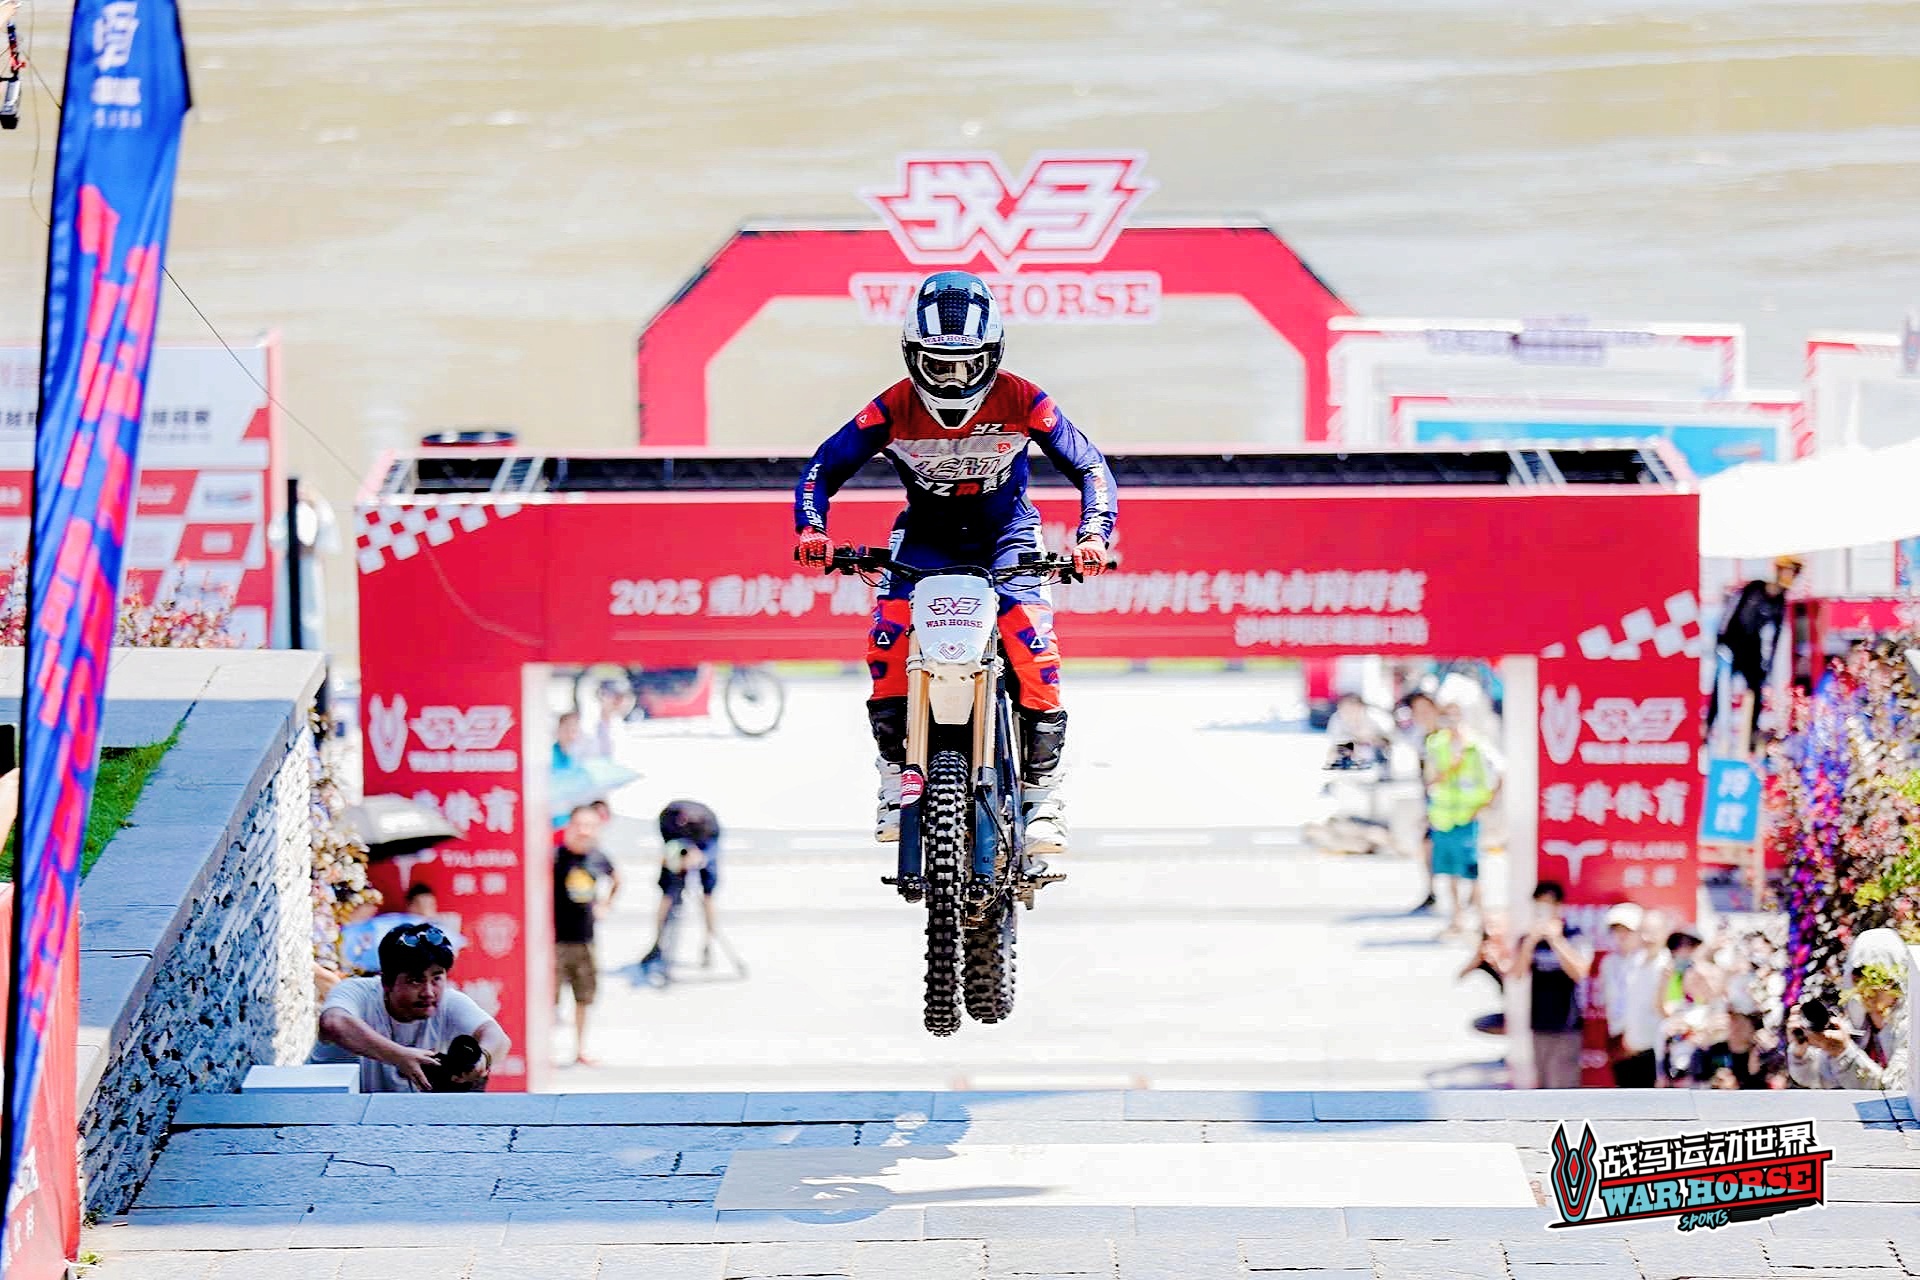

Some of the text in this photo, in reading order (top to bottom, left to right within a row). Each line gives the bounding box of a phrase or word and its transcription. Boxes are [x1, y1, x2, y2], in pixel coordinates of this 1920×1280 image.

[609, 578, 702, 616] 2025
[926, 618, 983, 629] WAR HORSE
